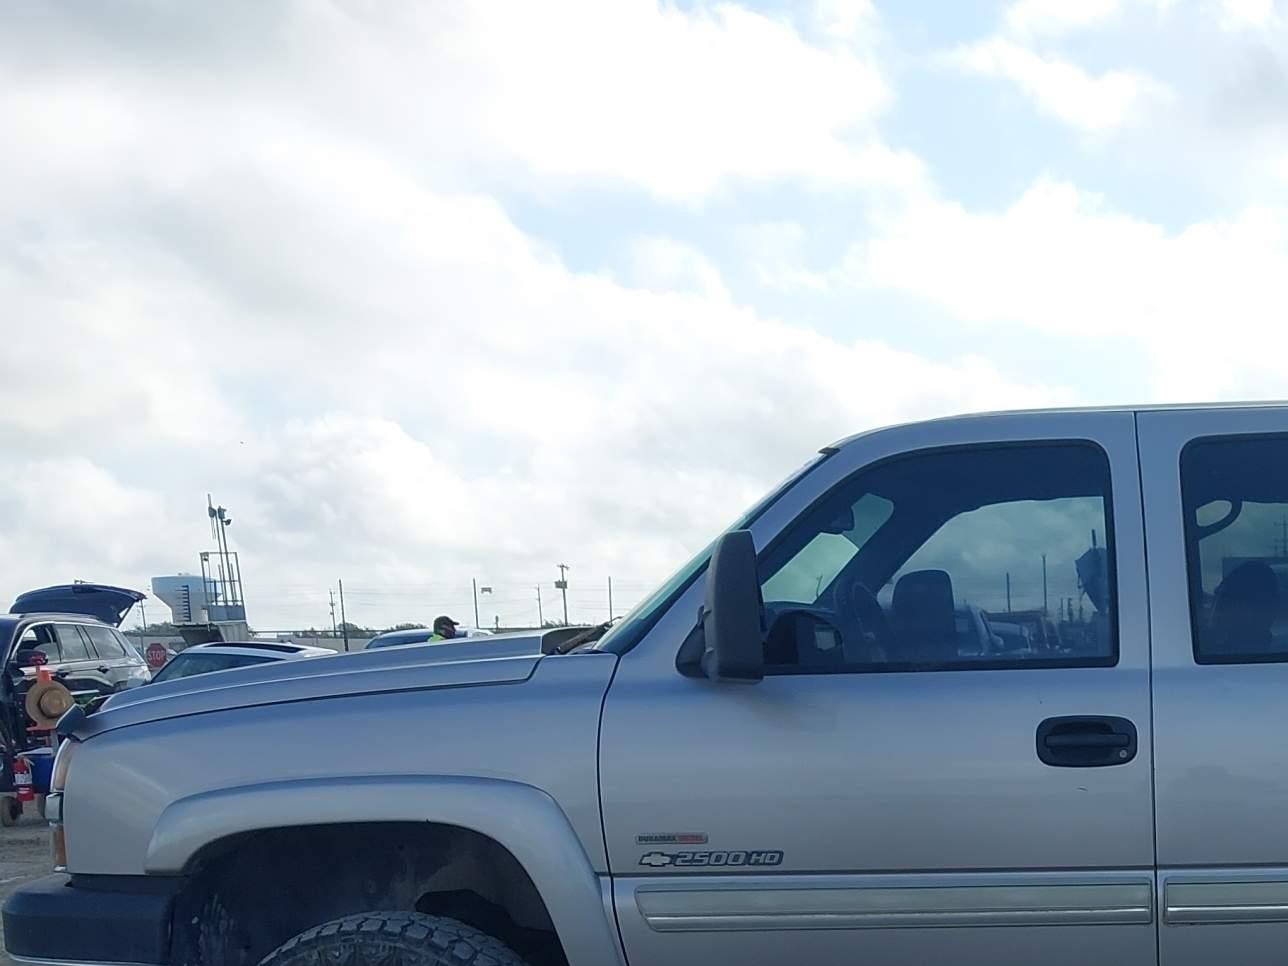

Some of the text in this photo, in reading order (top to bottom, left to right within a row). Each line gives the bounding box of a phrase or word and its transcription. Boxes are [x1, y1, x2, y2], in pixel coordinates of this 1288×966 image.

[147, 649, 166, 661] STOP
[675, 851, 781, 865] 2500 HD
